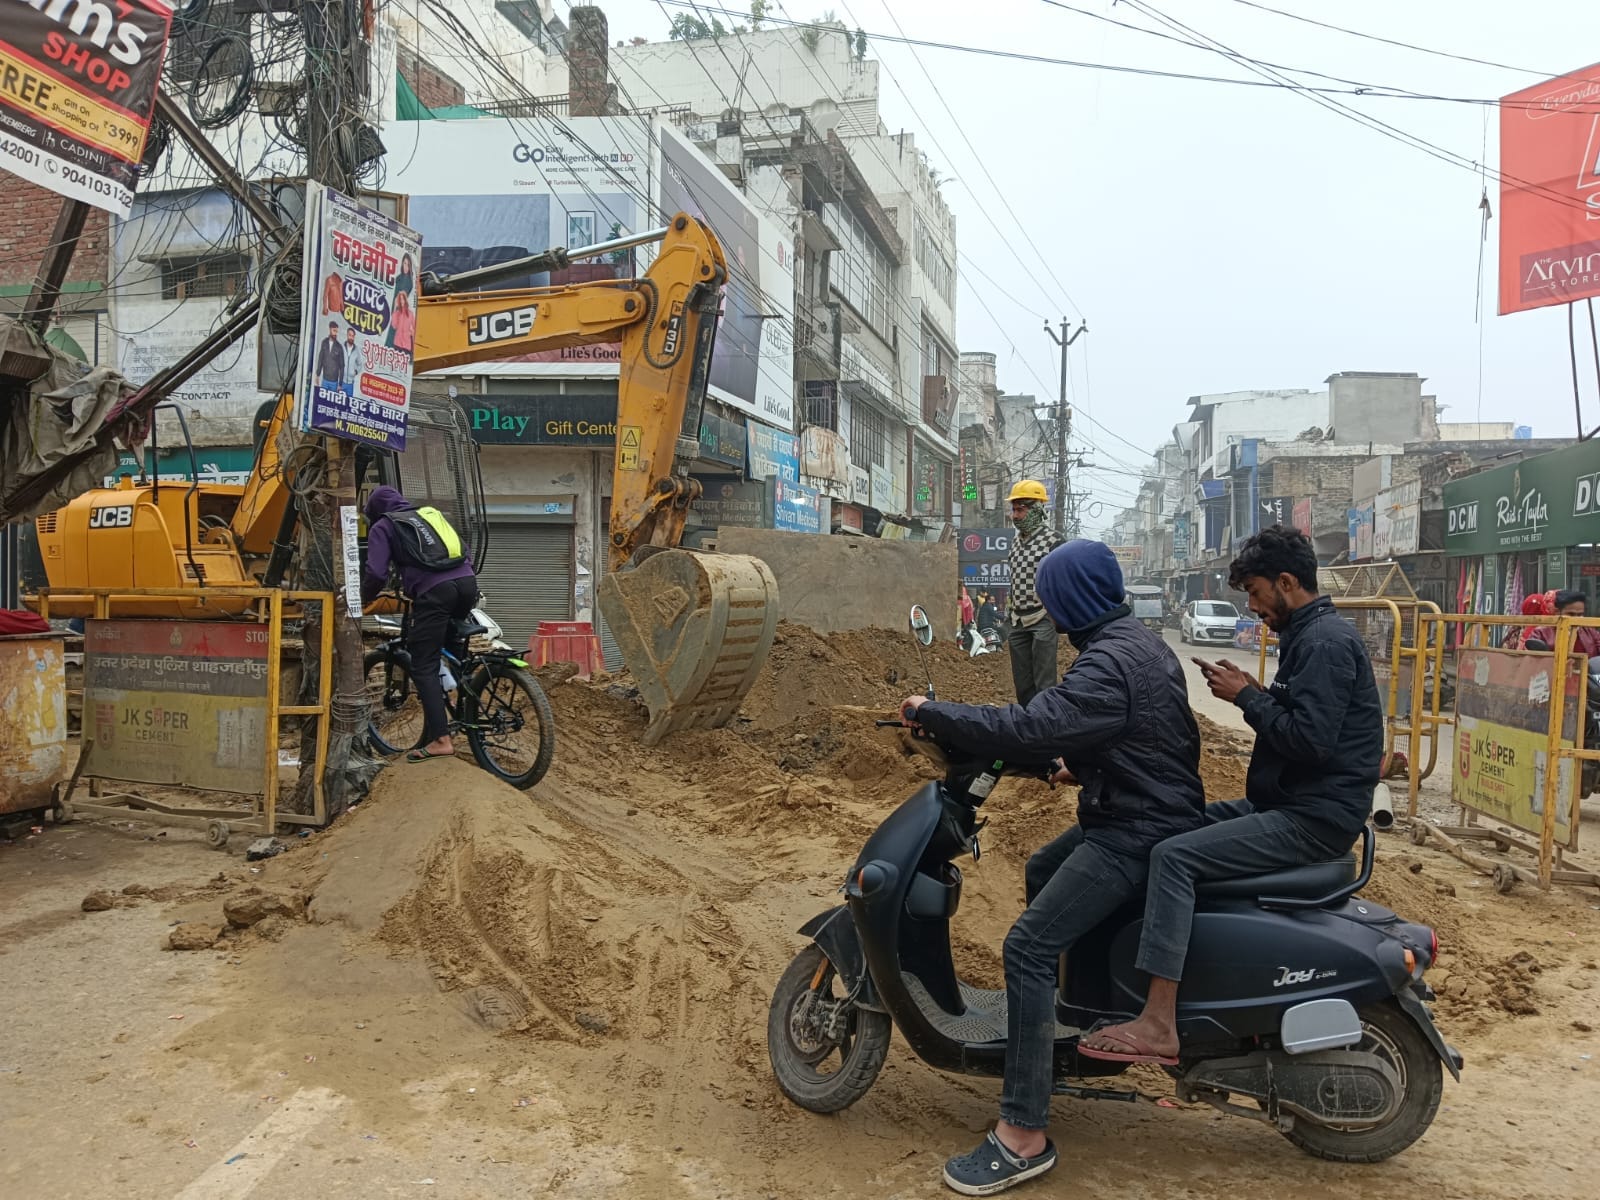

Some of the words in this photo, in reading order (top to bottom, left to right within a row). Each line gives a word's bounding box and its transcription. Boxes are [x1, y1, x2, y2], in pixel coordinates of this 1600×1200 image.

[42, 31, 131, 93] SHOP
[51, 103, 87, 128] Shopping
[63, 98, 78, 110] Gift
[80, 105, 90, 117] On
[60, 139, 103, 165] CADINI
[513, 143, 545, 163] Go
[784, 250, 792, 271] LG
[1550, 272, 1599, 290] STORE
[469, 307, 537, 343] JCB
[664, 317, 679, 353] 130
[560, 346, 591, 359] Life's
[181, 391, 232, 401] CONTACT
[318, 387, 346, 406] भारी
[348, 396, 368, 415] छूट
[369, 398, 380, 415] के
[335, 419, 345, 433] M.
[471, 408, 531, 437] Play
[545, 420, 573, 436] Gift
[90, 505, 133, 528] JCB
[1448, 504, 1478, 533] DCM
[1522, 487, 1549, 533] Taylor
[985, 536, 1008, 551] LG
[1521, 534, 1530, 543] THE
[1531, 533, 1542, 542] BEST
[154, 655, 189, 676] पुलिस
[121, 708, 140, 726] JK
[135, 729, 175, 742] CEMENT
[1473, 739, 1485, 758] JK
[1481, 761, 1505, 779] CEMENT
